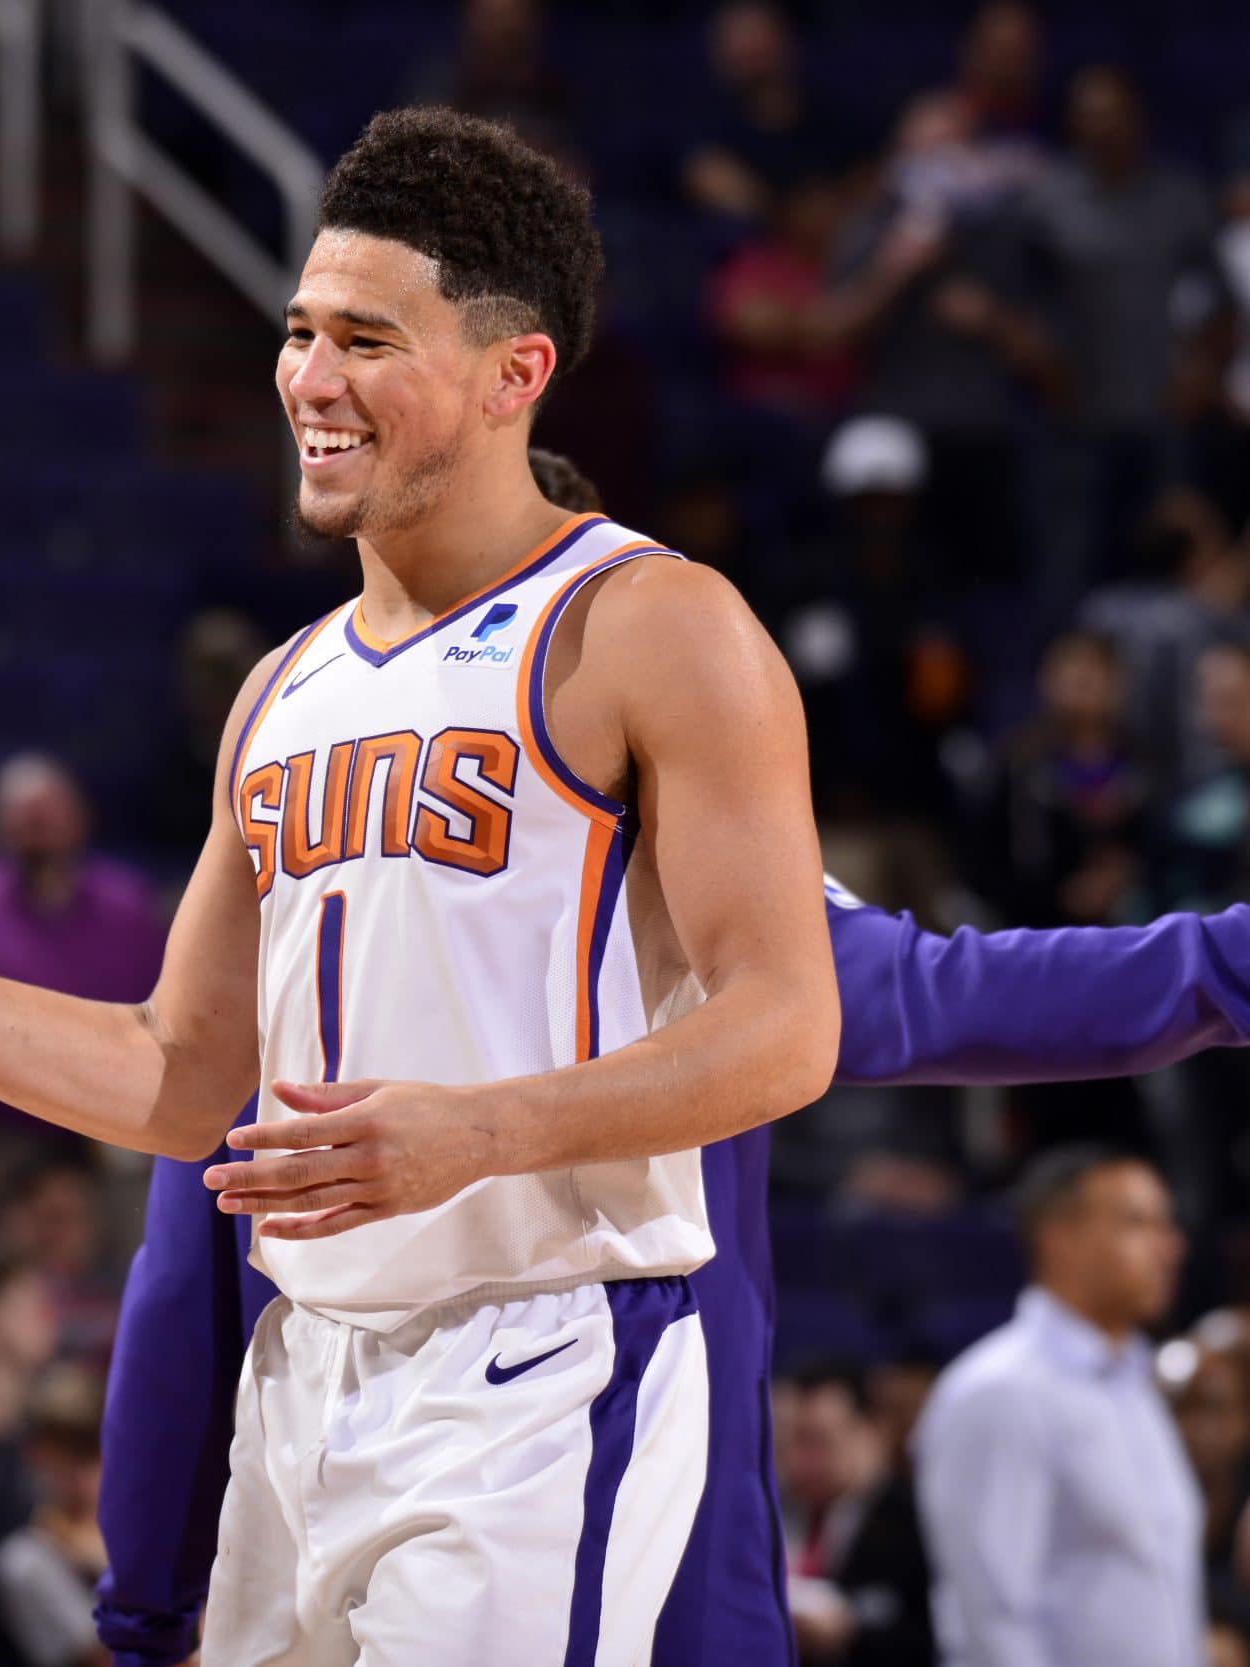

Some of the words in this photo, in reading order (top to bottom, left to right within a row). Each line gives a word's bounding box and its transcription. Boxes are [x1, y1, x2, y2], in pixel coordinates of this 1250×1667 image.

[443, 646, 513, 663] PayPal
[240, 726, 520, 901] SUNS
[316, 889, 347, 1083] 1
